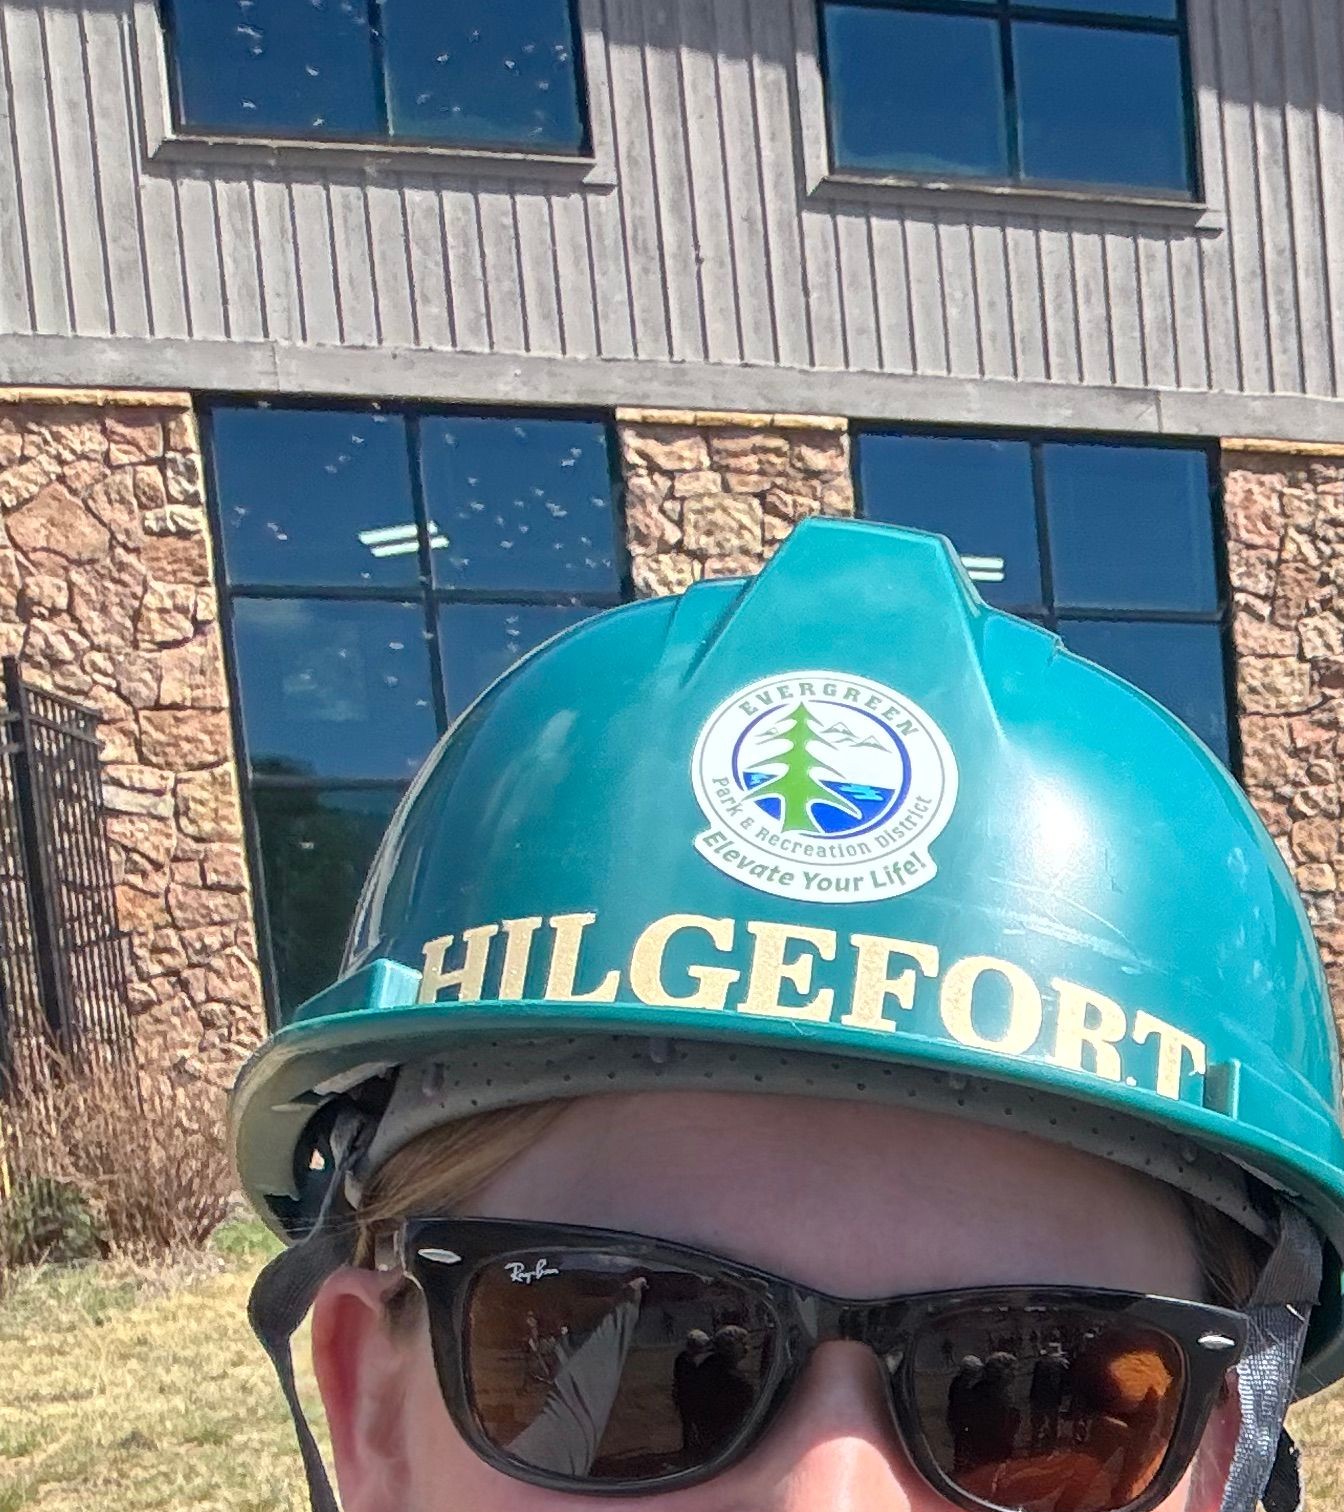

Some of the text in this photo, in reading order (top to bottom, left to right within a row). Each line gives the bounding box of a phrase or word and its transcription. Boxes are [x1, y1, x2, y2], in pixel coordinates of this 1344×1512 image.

[738, 681, 920, 738] EVERGREEN
[711, 776, 933, 860] Park & Recreation District
[702, 829, 927, 892] Elevate Your Life!
[420, 912, 1207, 1101] HILGEFORT
